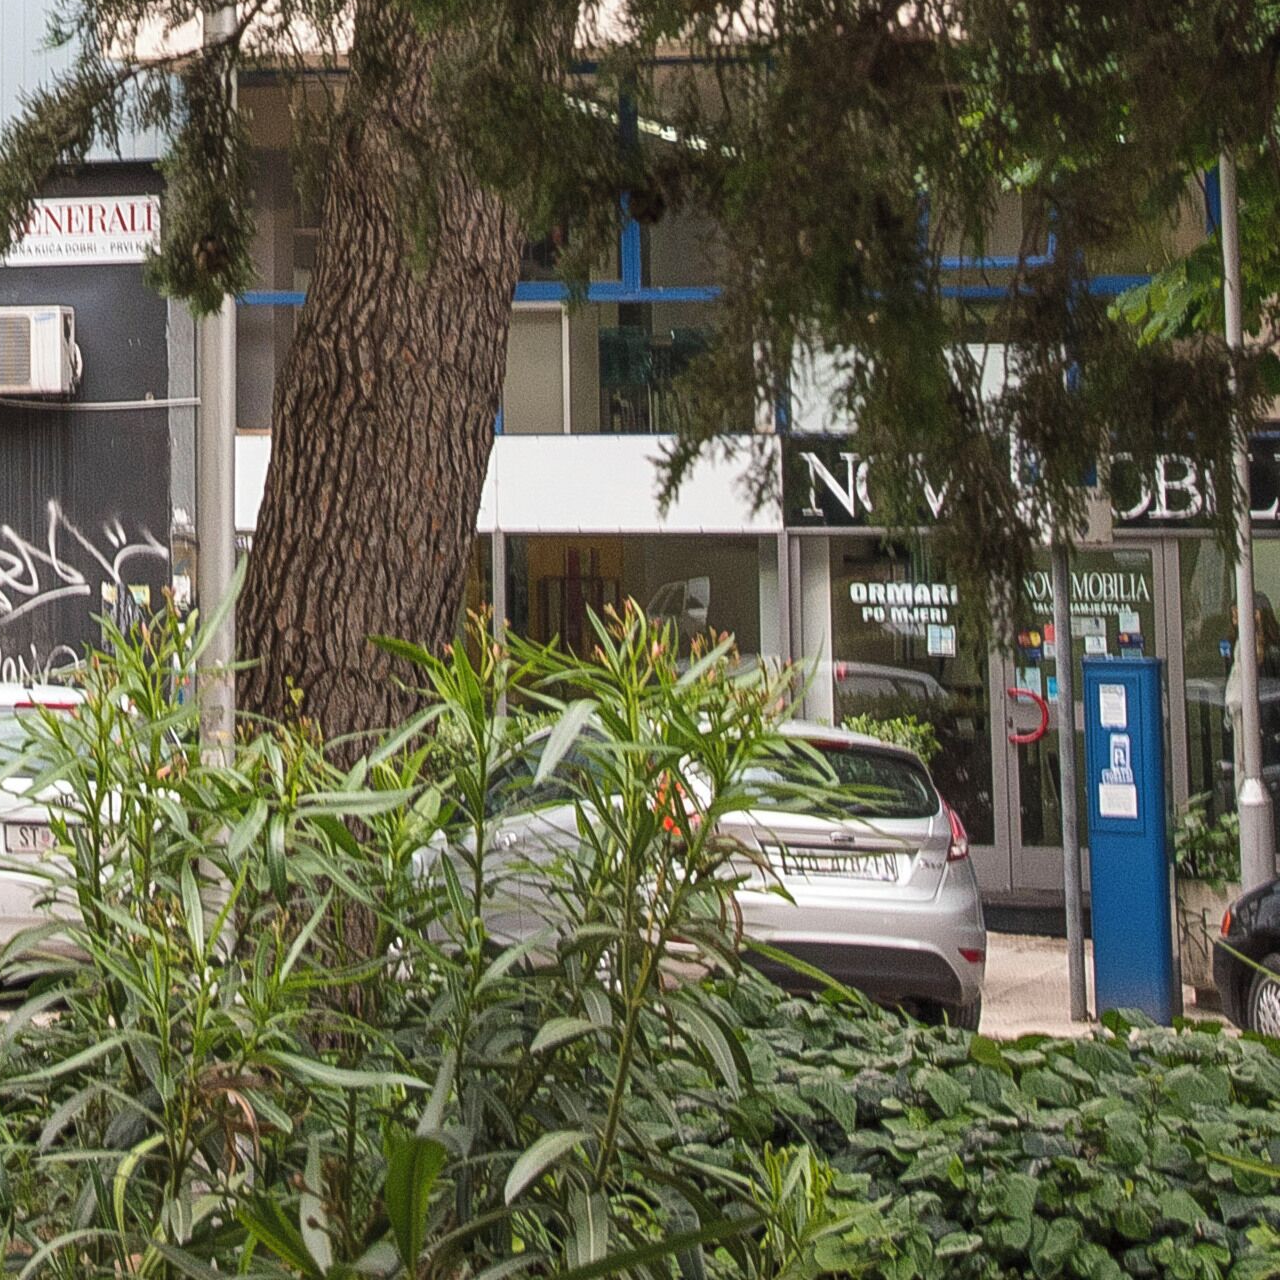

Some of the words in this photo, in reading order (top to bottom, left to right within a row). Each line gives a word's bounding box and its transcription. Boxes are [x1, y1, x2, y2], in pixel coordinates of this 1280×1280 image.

[24, 201, 155, 236] ENERALI
[850, 582, 959, 606] ORMARI
[1071, 572, 1150, 602] MOBILIA
[862, 606, 886, 623] PO
[19, 826, 39, 848] ST
